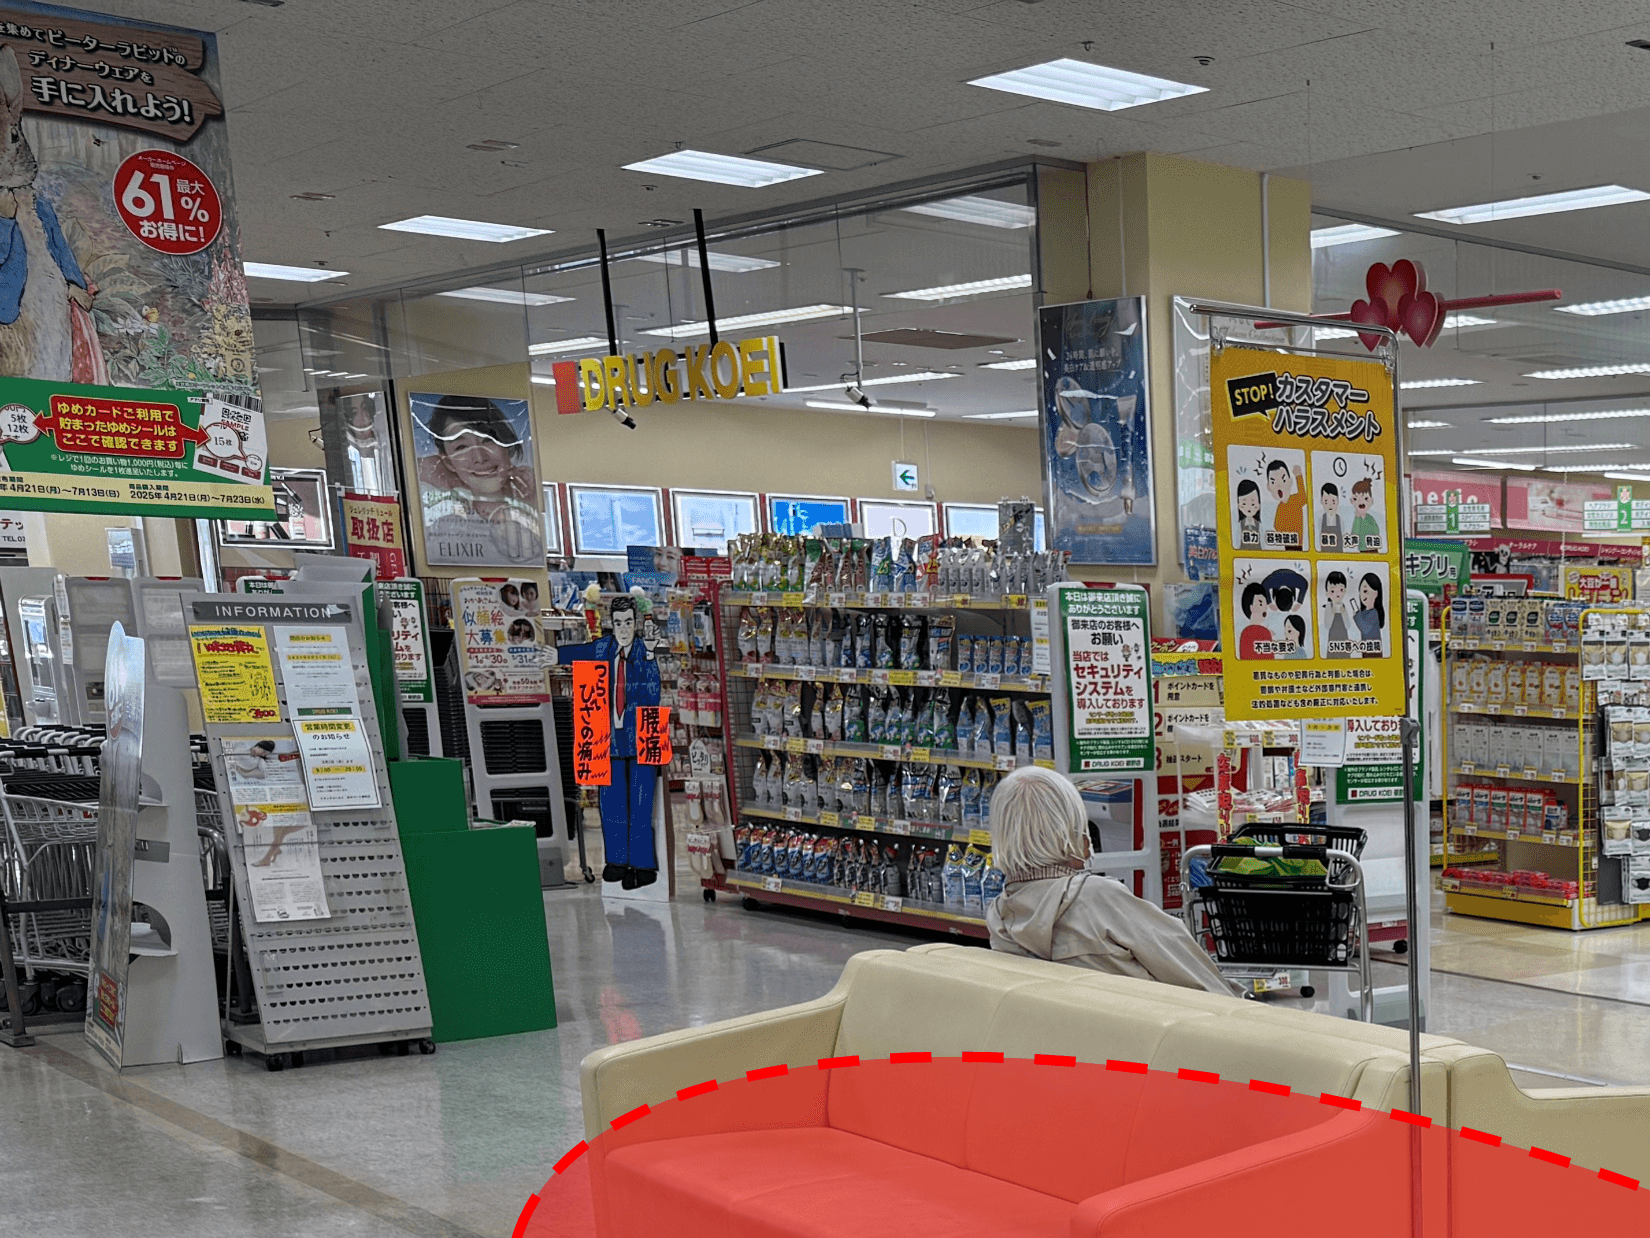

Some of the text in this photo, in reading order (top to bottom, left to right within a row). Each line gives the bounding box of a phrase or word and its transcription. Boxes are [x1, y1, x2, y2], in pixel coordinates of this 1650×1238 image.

[28, 50, 153, 84] ディナーウェアを
[31, 76, 192, 122] 手に入れよう!
[139, 219, 206, 243] お得に!
[580, 336, 780, 412] DRUG KOEI
[1233, 383, 1275, 406] STOP!
[1275, 372, 1370, 405] カスタマー
[57, 402, 175, 421] ゆめカードご利用で
[59, 418, 177, 437] 貯まったゆめシールは
[1272, 405, 1382, 442] ハラスメント
[62, 434, 178, 452] ここで確認できます
[1620, 510, 1628, 524] 2
[350, 516, 395, 544] 取扱店
[1243, 532, 1259, 543] 暴力
[1266, 533, 1298, 545] 器物破損
[1343, 535, 1359, 547] 大声
[438, 542, 485, 558] ELIXIR
[1064, 591, 1142, 603] 本日は御来店頂き誠に
[215, 605, 333, 619] INFORMATION
[1068, 604, 1141, 615] ありがとうございます
[1071, 619, 1140, 631] 御来店のお客様へ
[1090, 632, 1124, 646] お願い
[1254, 642, 1295, 653] 不当な要求
[1072, 651, 1109, 662] 当店では
[1073, 663, 1143, 679] セキュリティ
[594, 664, 607, 711] つらい
[1075, 680, 1134, 697] システムを
[1167, 682, 1215, 691] ポイントカードを
[1076, 698, 1145, 710] 導入しております
[1167, 714, 1210, 723] ポイントカードを
[576, 683, 595, 780] ひざの痛み
[638, 708, 661, 764] 腰痛
